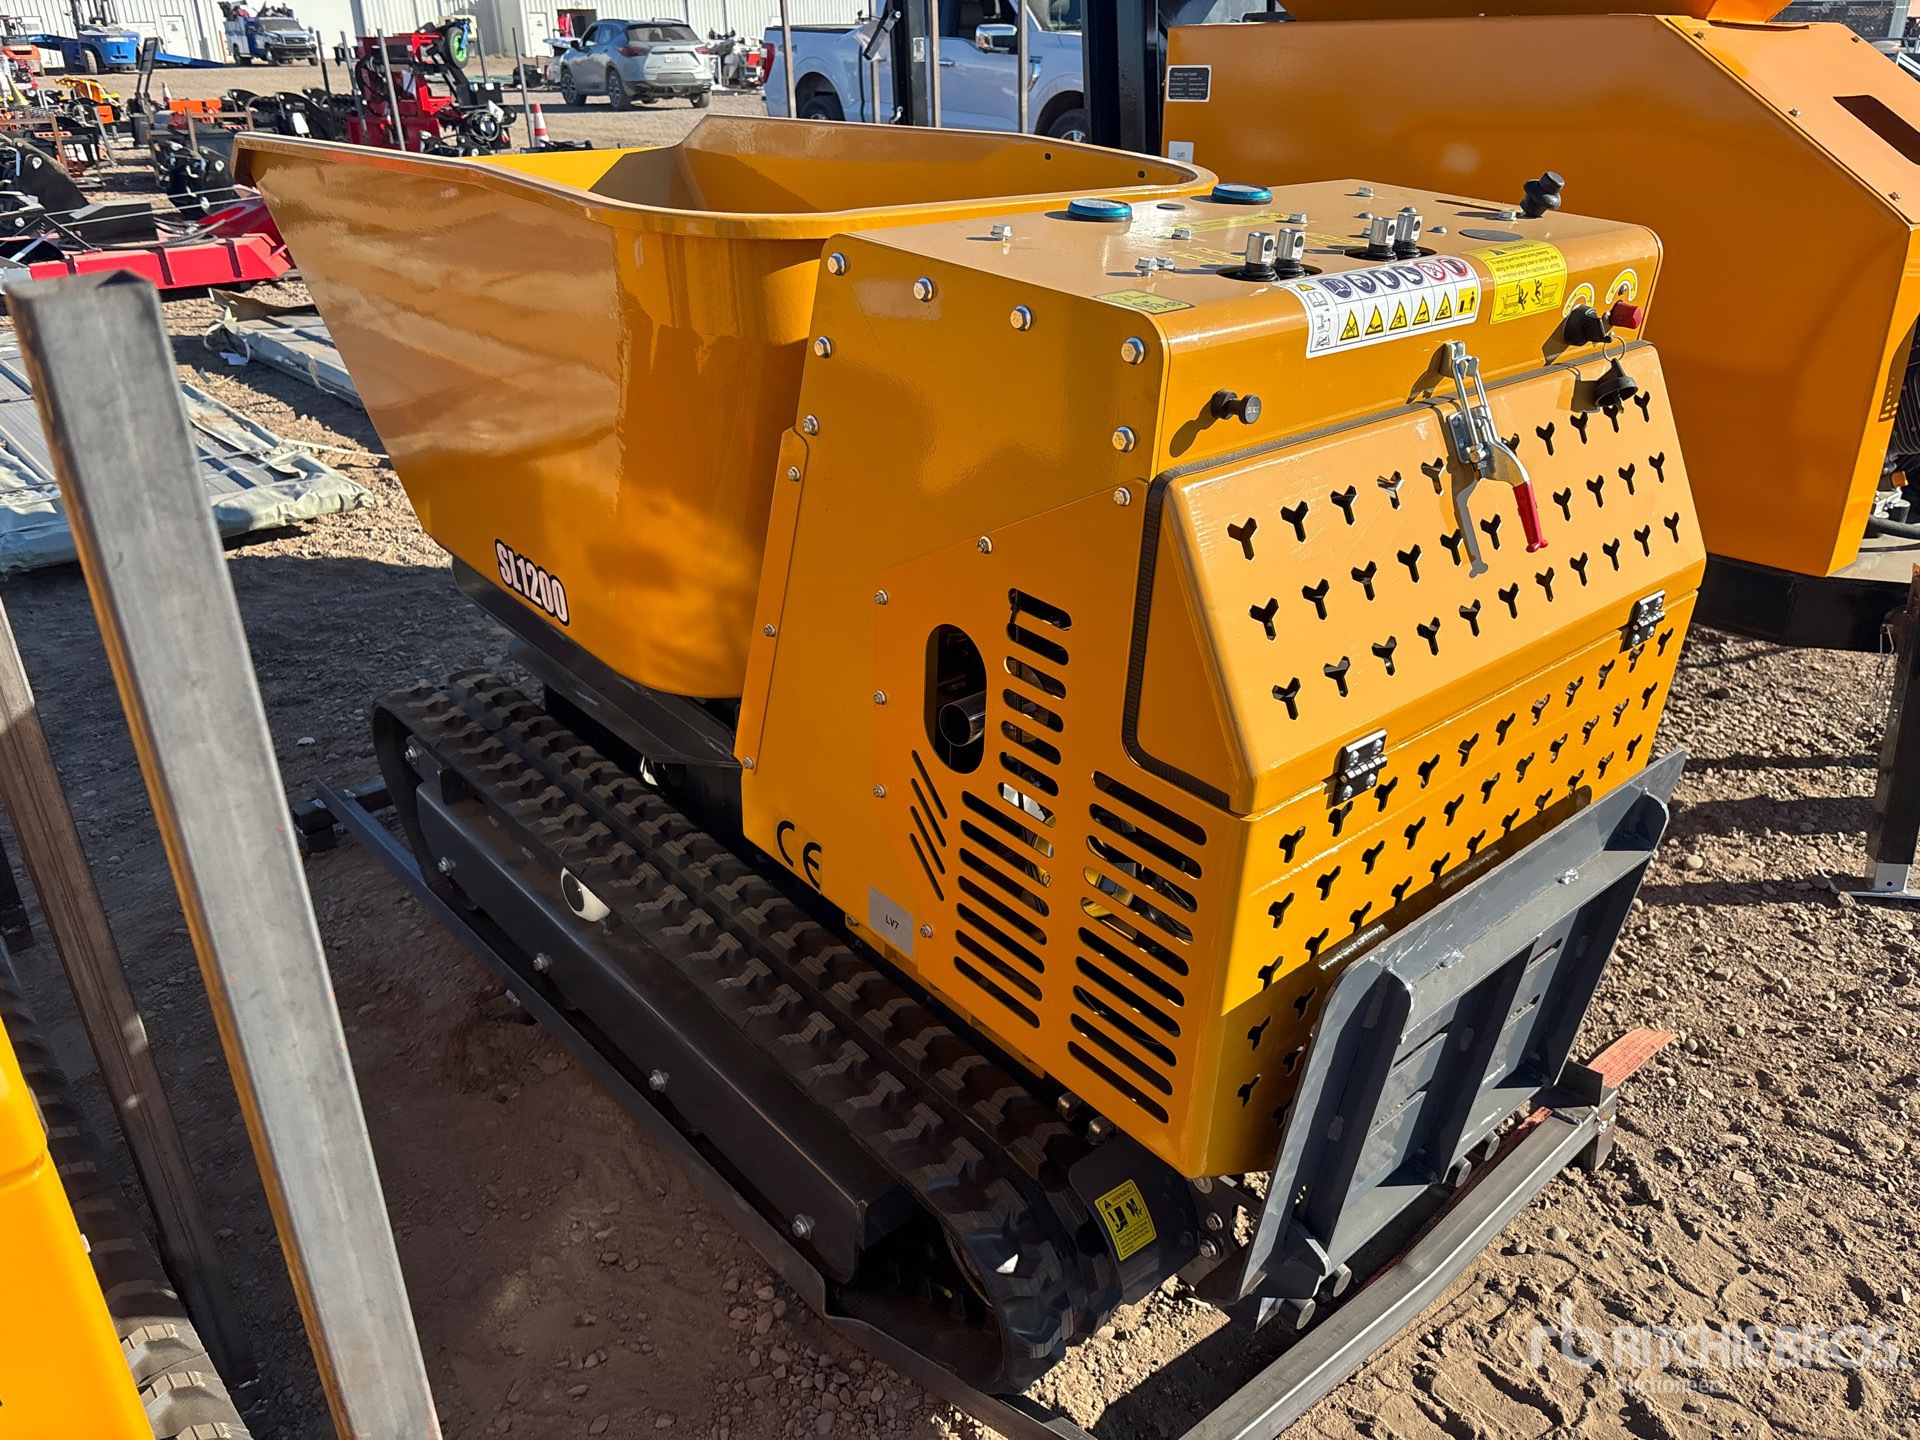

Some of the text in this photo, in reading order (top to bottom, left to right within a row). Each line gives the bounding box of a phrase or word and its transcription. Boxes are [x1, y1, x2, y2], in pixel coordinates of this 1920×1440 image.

[495, 539, 570, 626] SL1200
[776, 820, 822, 891] CE
[885, 914, 899, 930] LV7
